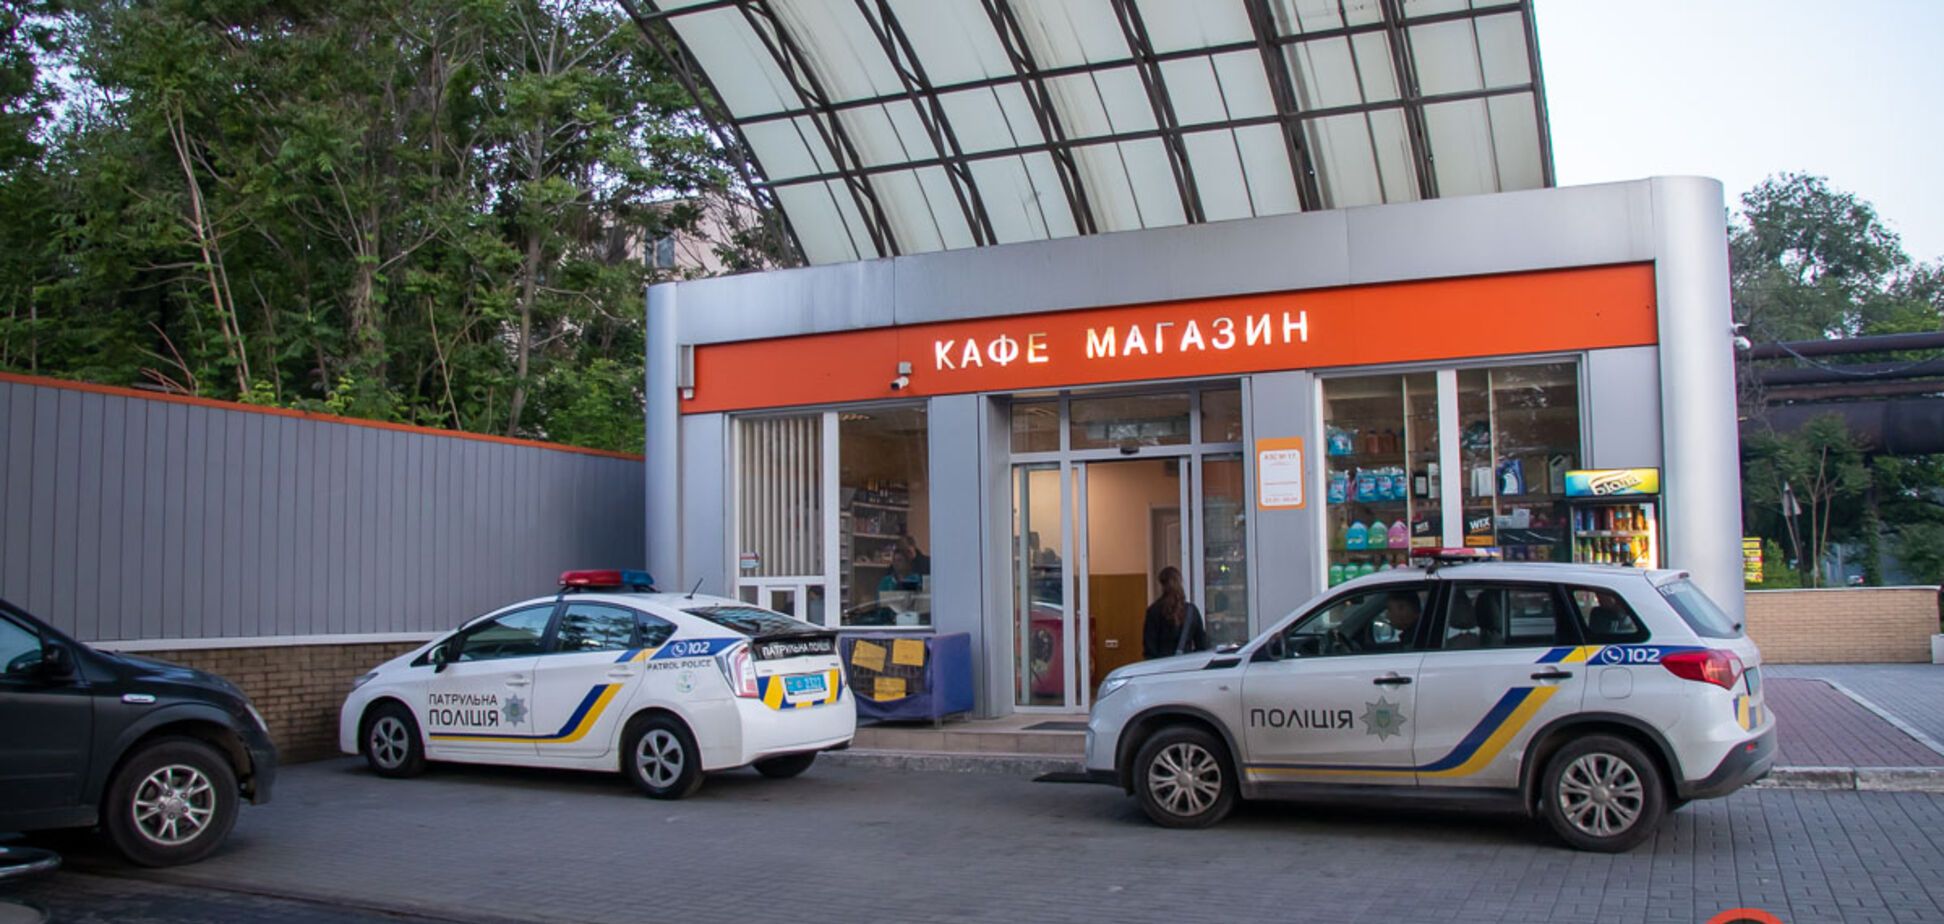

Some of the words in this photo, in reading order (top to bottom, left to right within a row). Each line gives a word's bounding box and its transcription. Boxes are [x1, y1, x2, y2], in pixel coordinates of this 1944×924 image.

[934, 332, 1050, 371] КАФЕ
[1085, 310, 1310, 360] МАГАЗИН
[1469, 516, 1491, 530] WIX
[688, 641, 711, 654] 102
[1627, 648, 1661, 663] 102
[647, 661, 679, 670] PATROL
[681, 659, 712, 669] POLICE
[429, 693, 498, 706] ПАТРУЛЬНА
[429, 708, 499, 728] ПОЛІЦІЯ
[1251, 708, 1354, 729] ПОЛІЦІЯ
